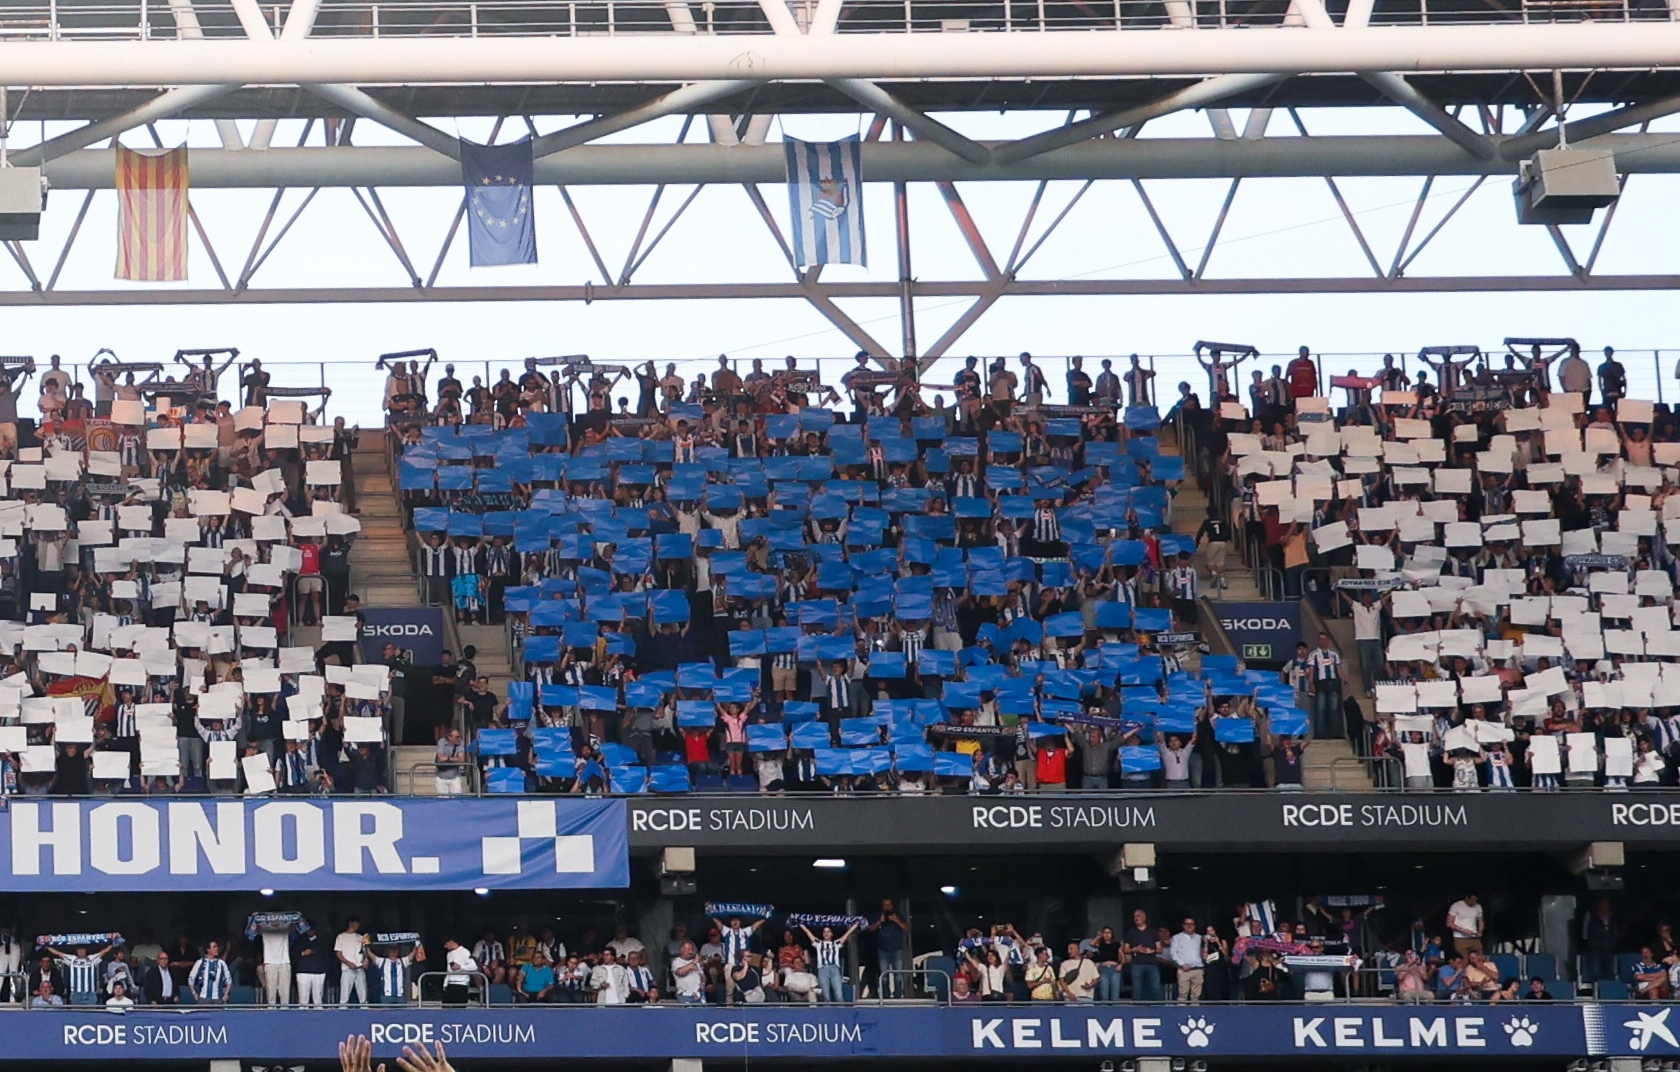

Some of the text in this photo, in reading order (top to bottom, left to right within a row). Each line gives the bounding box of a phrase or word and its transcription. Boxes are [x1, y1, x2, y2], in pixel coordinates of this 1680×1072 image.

[363, 625, 432, 635] SKODA
[1221, 619, 1290, 629] SKODA
[633, 810, 813, 830] RCDE STADIUM
[973, 806, 1155, 827] RCDE STADIUM
[1283, 805, 1467, 825] RCDE STADIUM
[1613, 804, 1680, 825] RCDE
[12, 802, 439, 874] HONOR.
[51, 934, 105, 943] RCD ESPANYOL
[65, 1025, 227, 1044] RCDE STADIUM
[371, 1024, 535, 1043] RCDE STADIUM
[697, 1023, 861, 1042] RCDE STADIUM
[973, 1019, 1162, 1047] KELME
[1294, 1018, 1485, 1046] KELME
